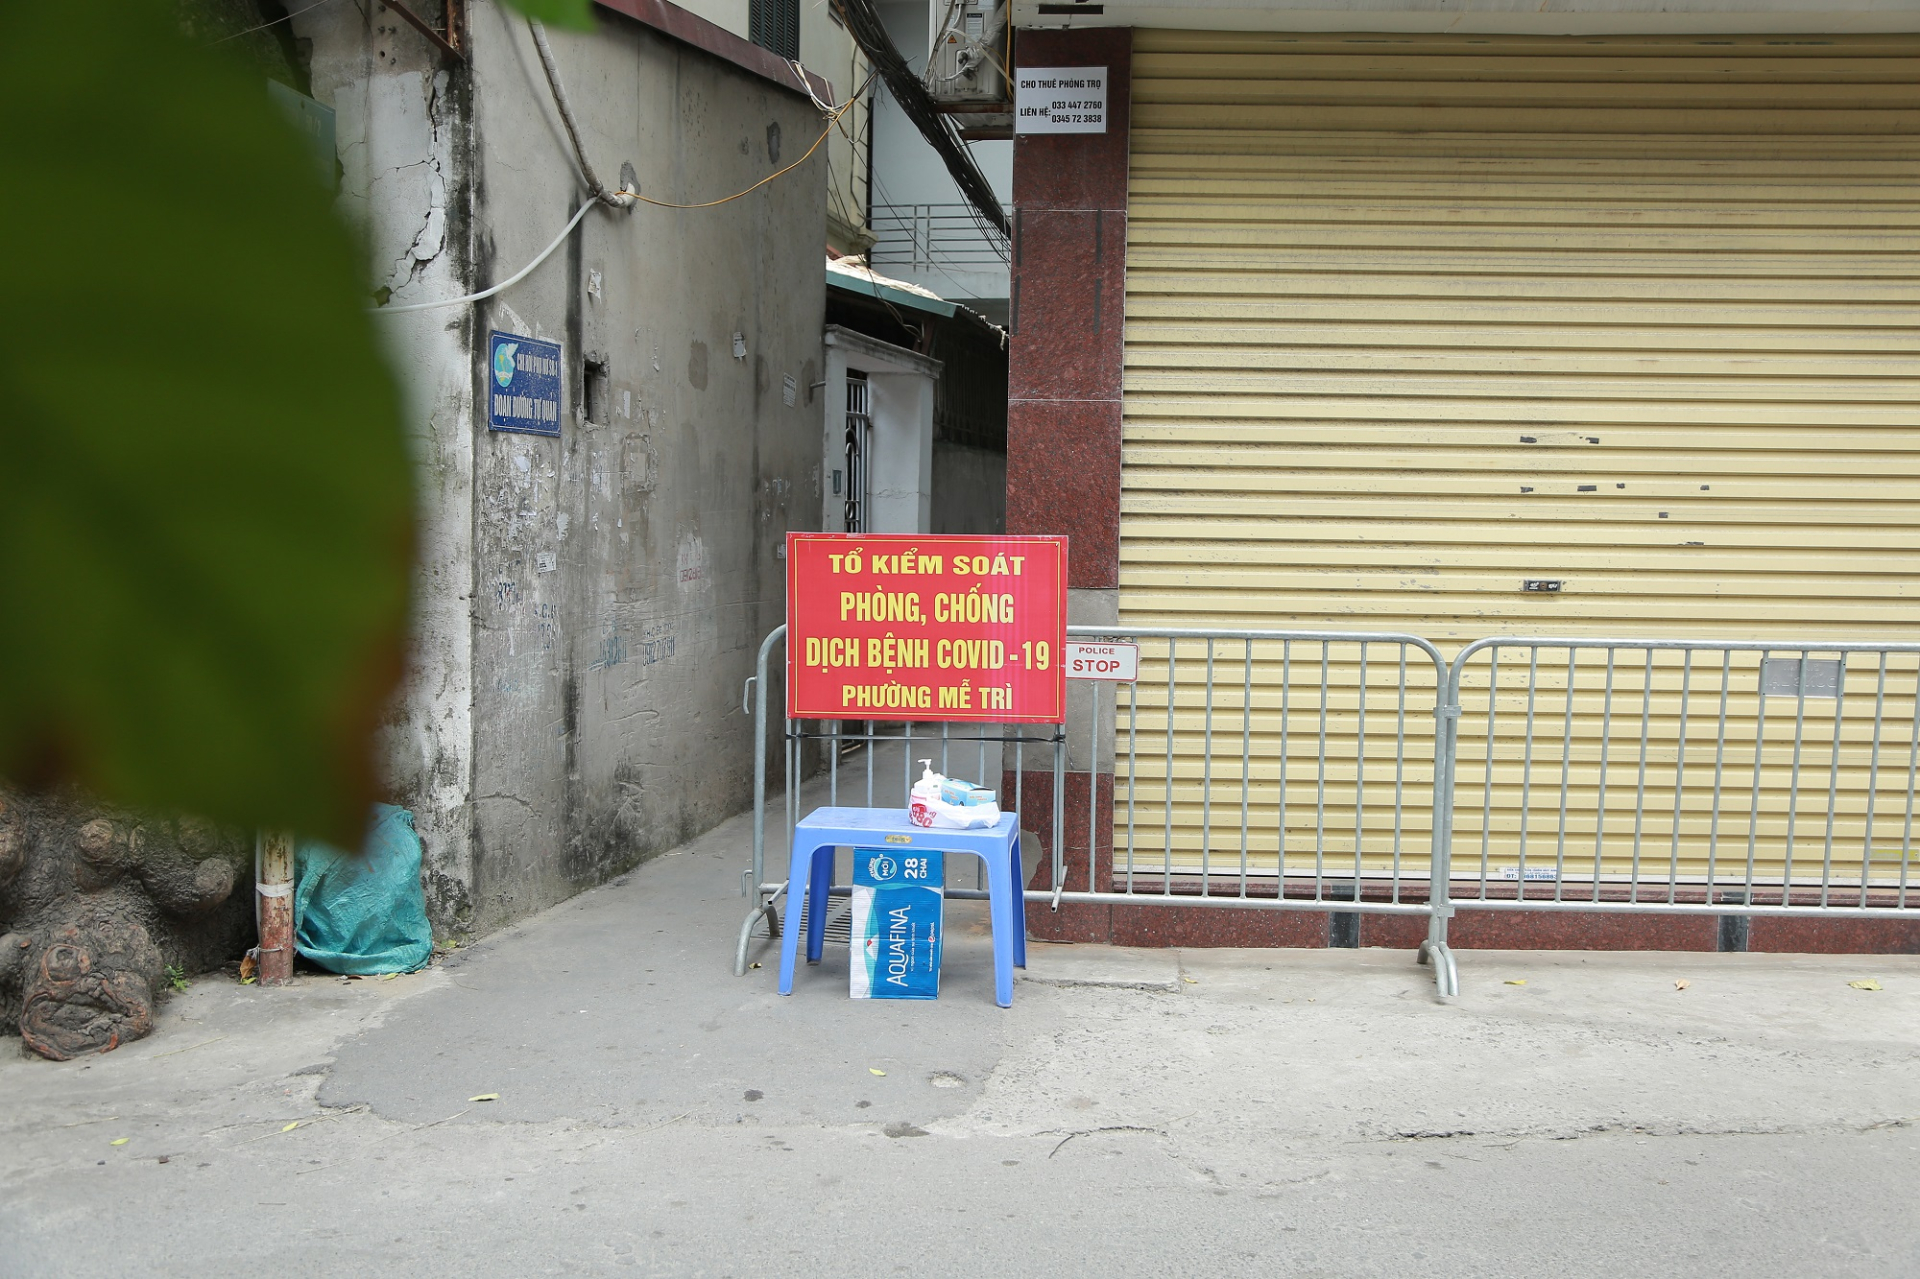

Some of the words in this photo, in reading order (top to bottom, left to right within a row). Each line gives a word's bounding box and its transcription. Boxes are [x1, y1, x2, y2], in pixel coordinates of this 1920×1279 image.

[1020, 80, 1036, 89] CHO
[1038, 78, 1057, 89] THUÊ
[1059, 78, 1085, 88] PHÒNG
[1087, 79, 1101, 90] TRỌ
[1020, 106, 1037, 116] LIÊN
[1039, 106, 1051, 118] HỆ:
[1051, 101, 1066, 110] 033
[1067, 101, 1082, 110] 447
[1083, 101, 1102, 110] 2760
[1051, 114, 1070, 123] 0345
[1072, 114, 1082, 123] 72
[1083, 114, 1102, 123] 3838
[828, 547, 863, 575] TỔ
[872, 547, 943, 575] KIỂM
[952, 552, 1025, 576] SOÁT
[840, 586, 927, 626] PHÒNG,
[934, 583, 1014, 624] CHỐNG
[806, 637, 860, 674] DỊCH
[867, 632, 929, 674] BỆNH
[936, 638, 1004, 670] COVID
[1078, 646, 1115, 655] POLICE
[1072, 659, 1121, 673] STOP
[842, 679, 931, 709] PHƯỜNG
[938, 678, 972, 710] MỄ
[978, 682, 1013, 710] TRÌ
[904, 858, 918, 879] 28
[919, 858, 928, 879] CHAI
[886, 905, 911, 987] AQUAFINA
